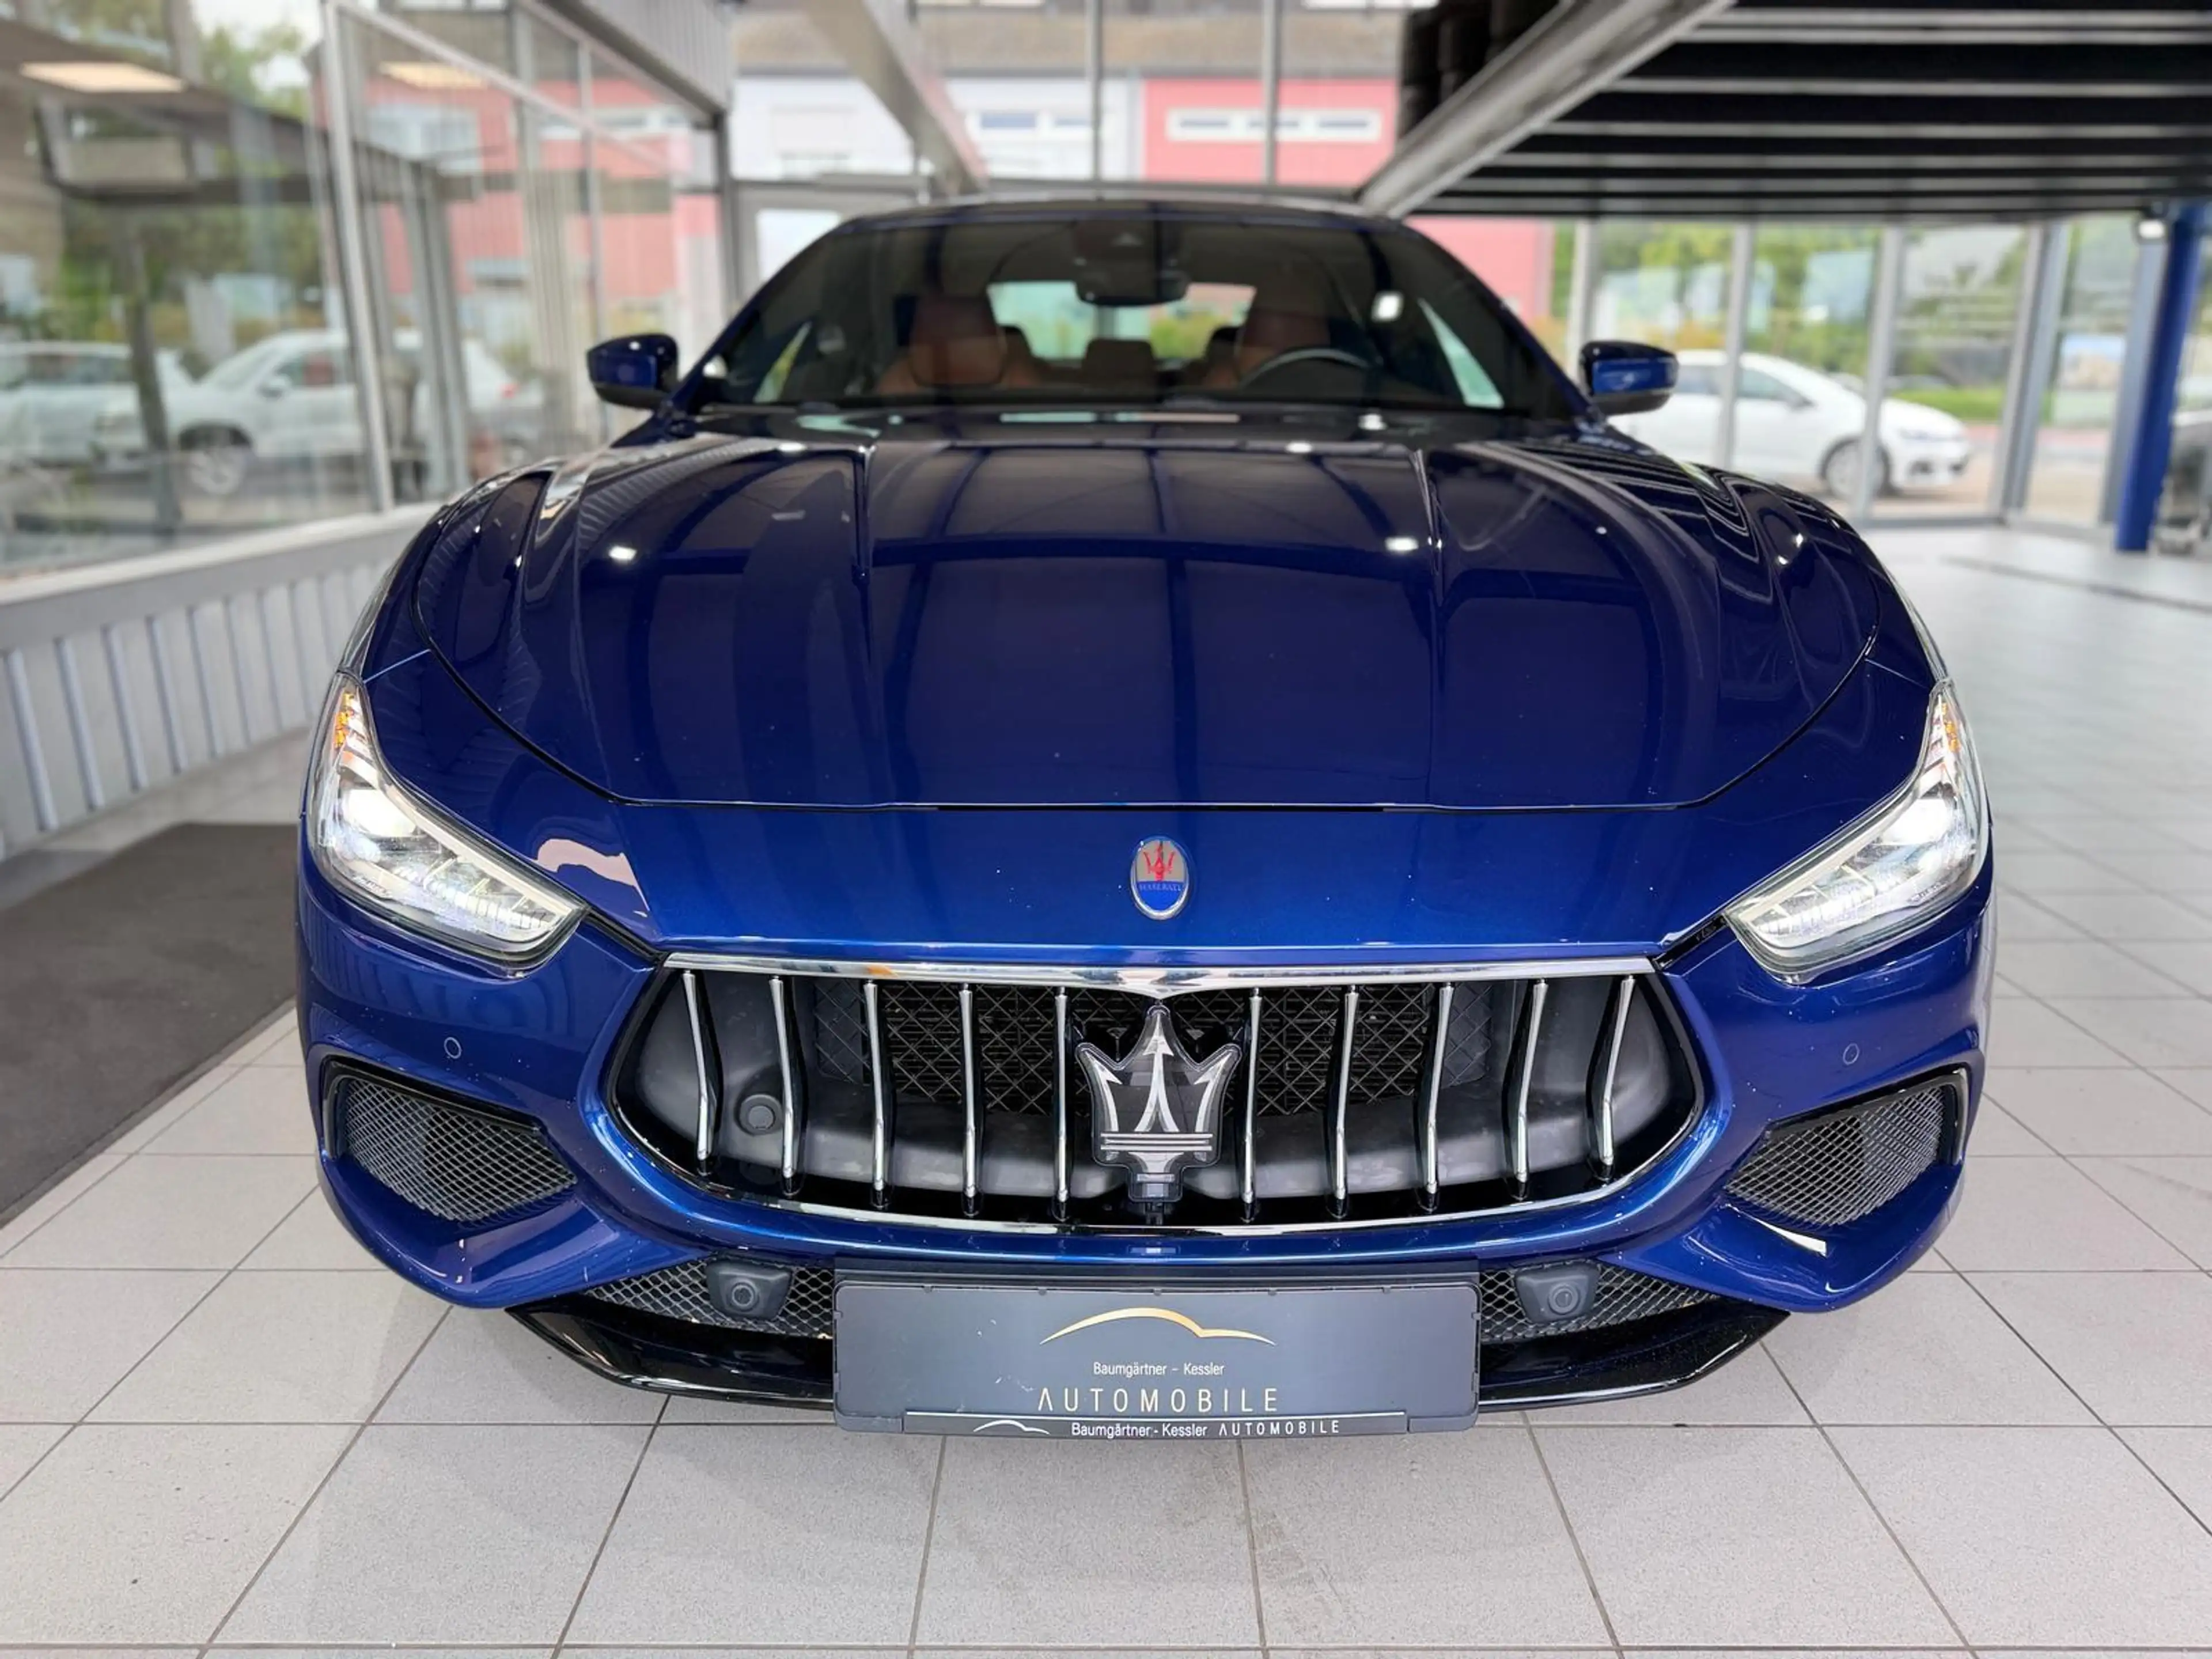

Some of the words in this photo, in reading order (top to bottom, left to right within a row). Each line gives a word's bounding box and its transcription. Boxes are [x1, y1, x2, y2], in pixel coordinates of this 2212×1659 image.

[1093, 1362, 1167, 1378] Baumgärtner
[1183, 1362, 1225, 1376] Kessler
[1038, 1388, 1277, 1412] AUTOMOBILE
[1071, 1422, 1152, 1439] Baumgärtner
[1162, 1423, 1207, 1437] Kessler
[1219, 1420, 1339, 1436] AUTOMOBILE
